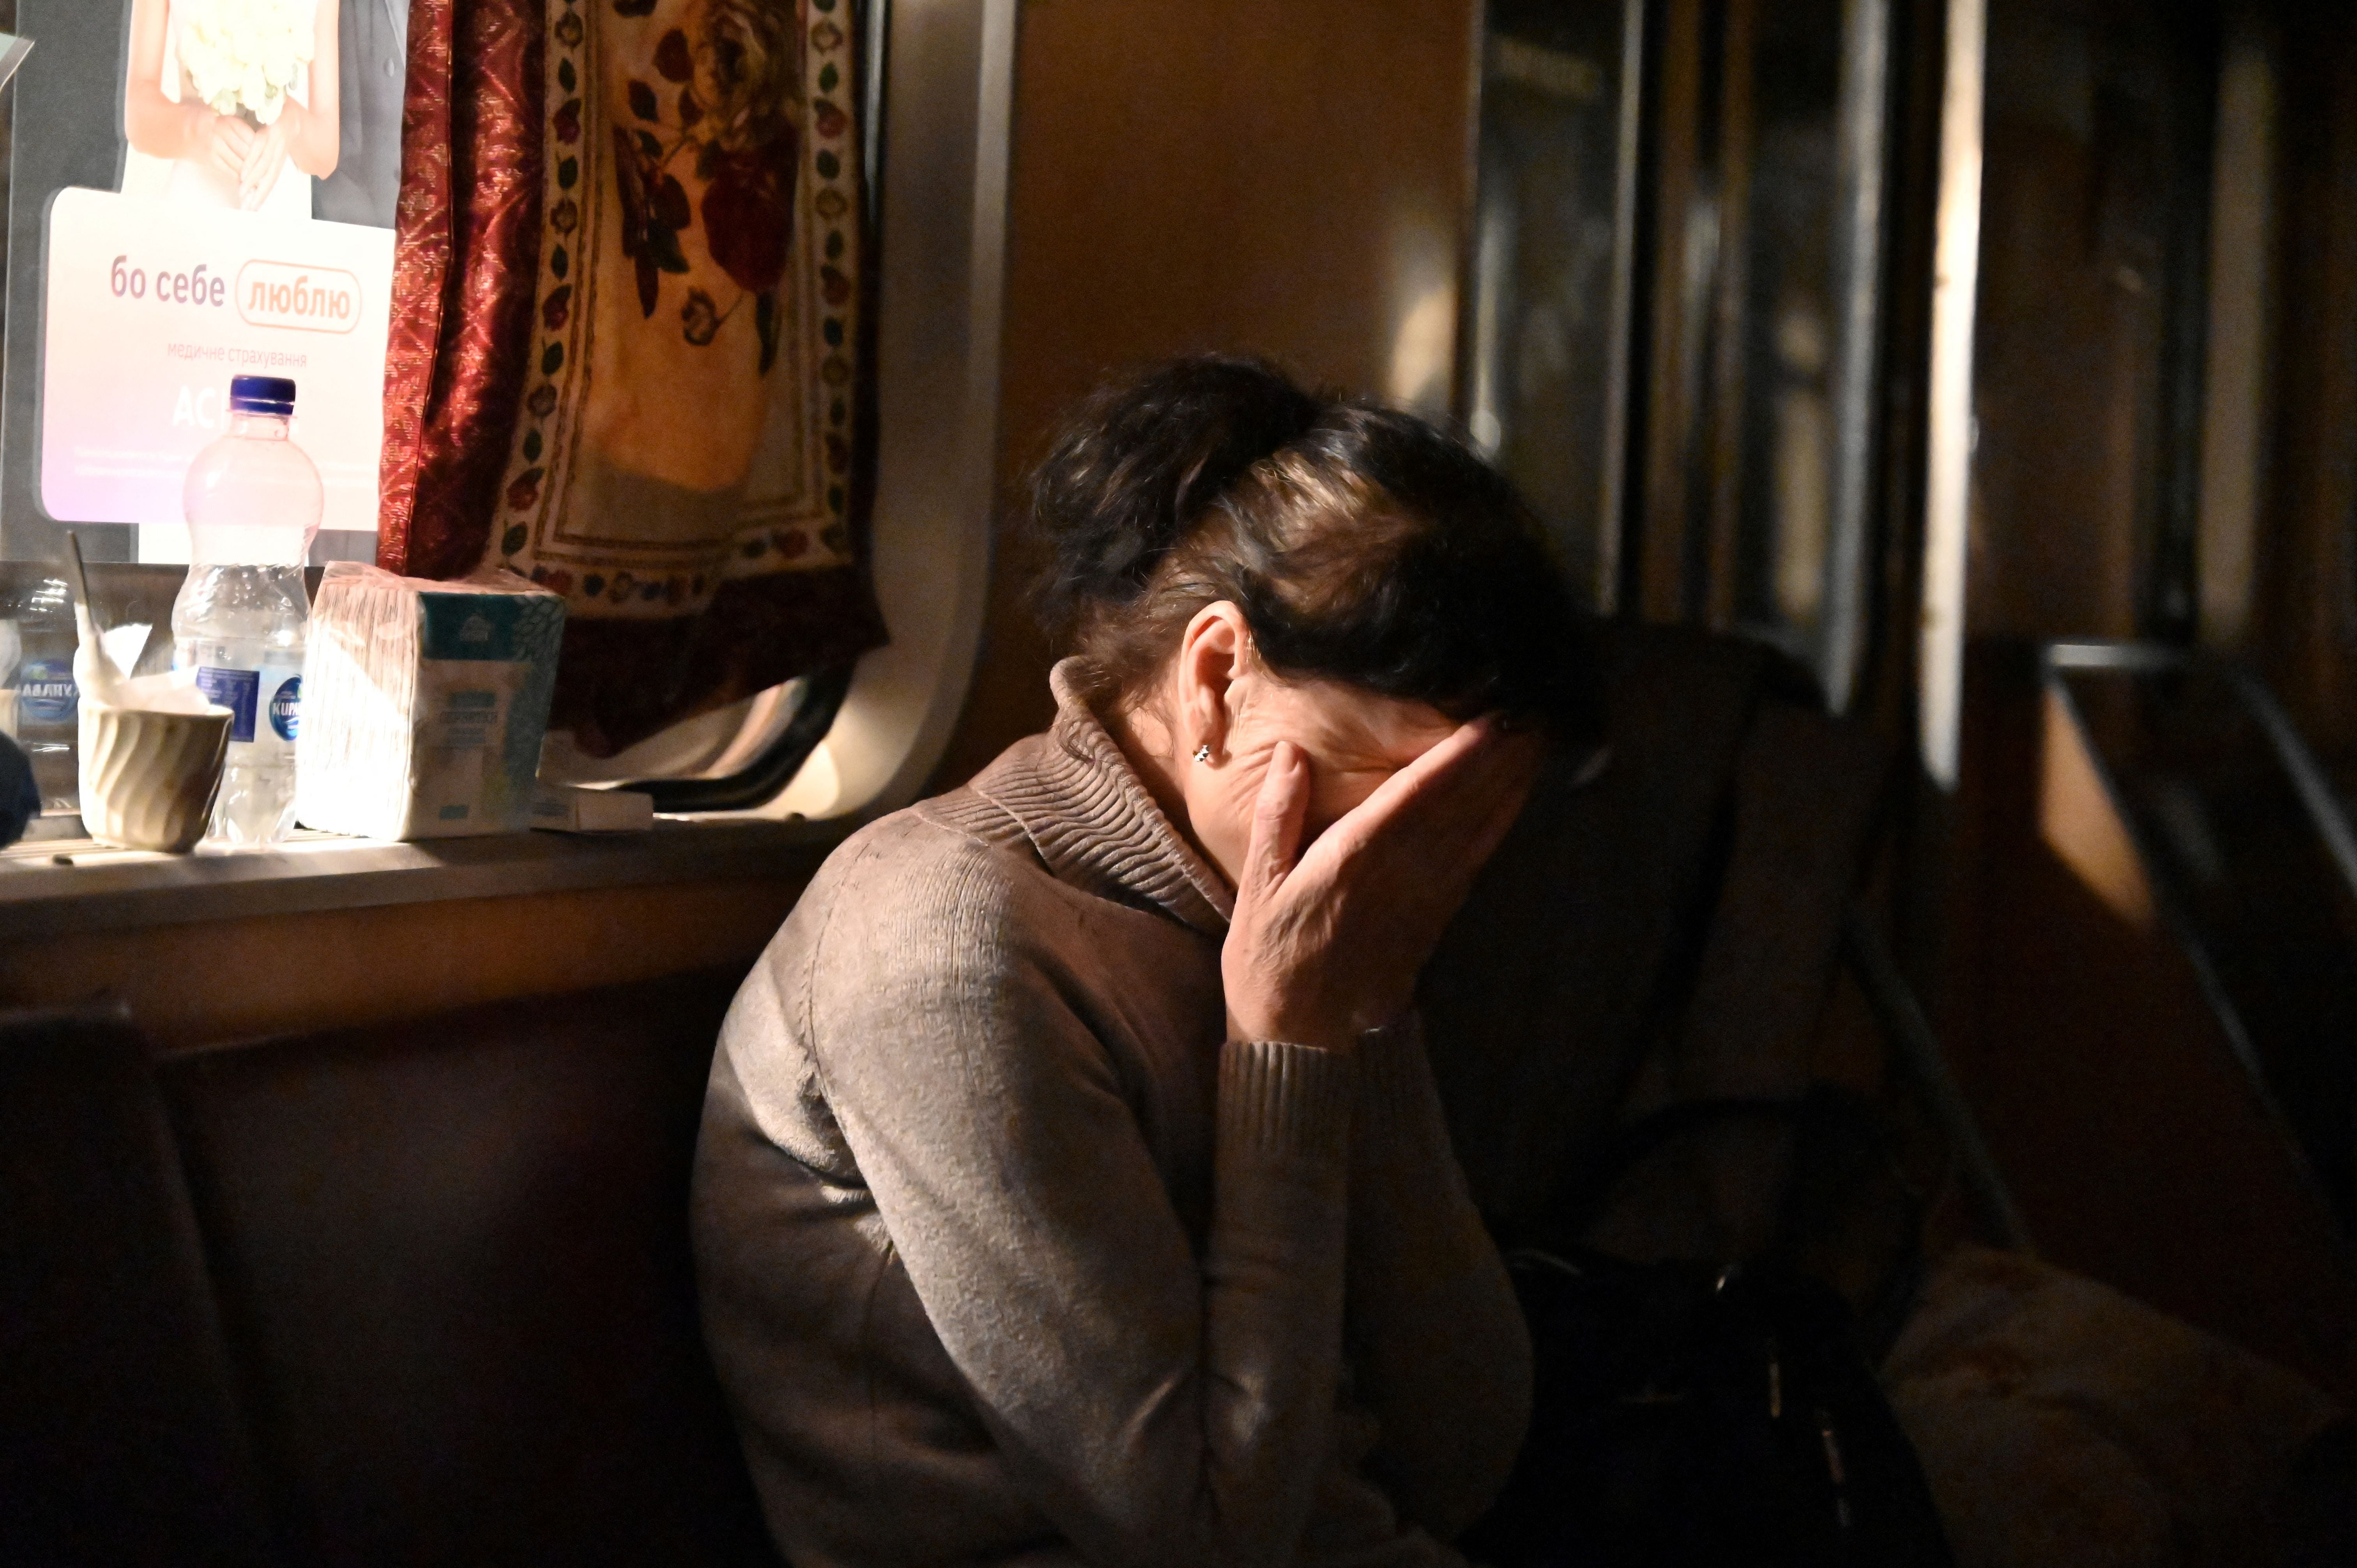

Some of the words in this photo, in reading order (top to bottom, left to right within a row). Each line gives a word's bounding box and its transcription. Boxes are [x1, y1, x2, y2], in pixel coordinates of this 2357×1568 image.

[111, 255, 146, 299] бо
[156, 263, 225, 307] себе
[248, 275, 350, 320] люблю
[168, 343, 225, 361] медичне
[228, 348, 307, 369] страхування
[172, 385, 230, 431] АС
